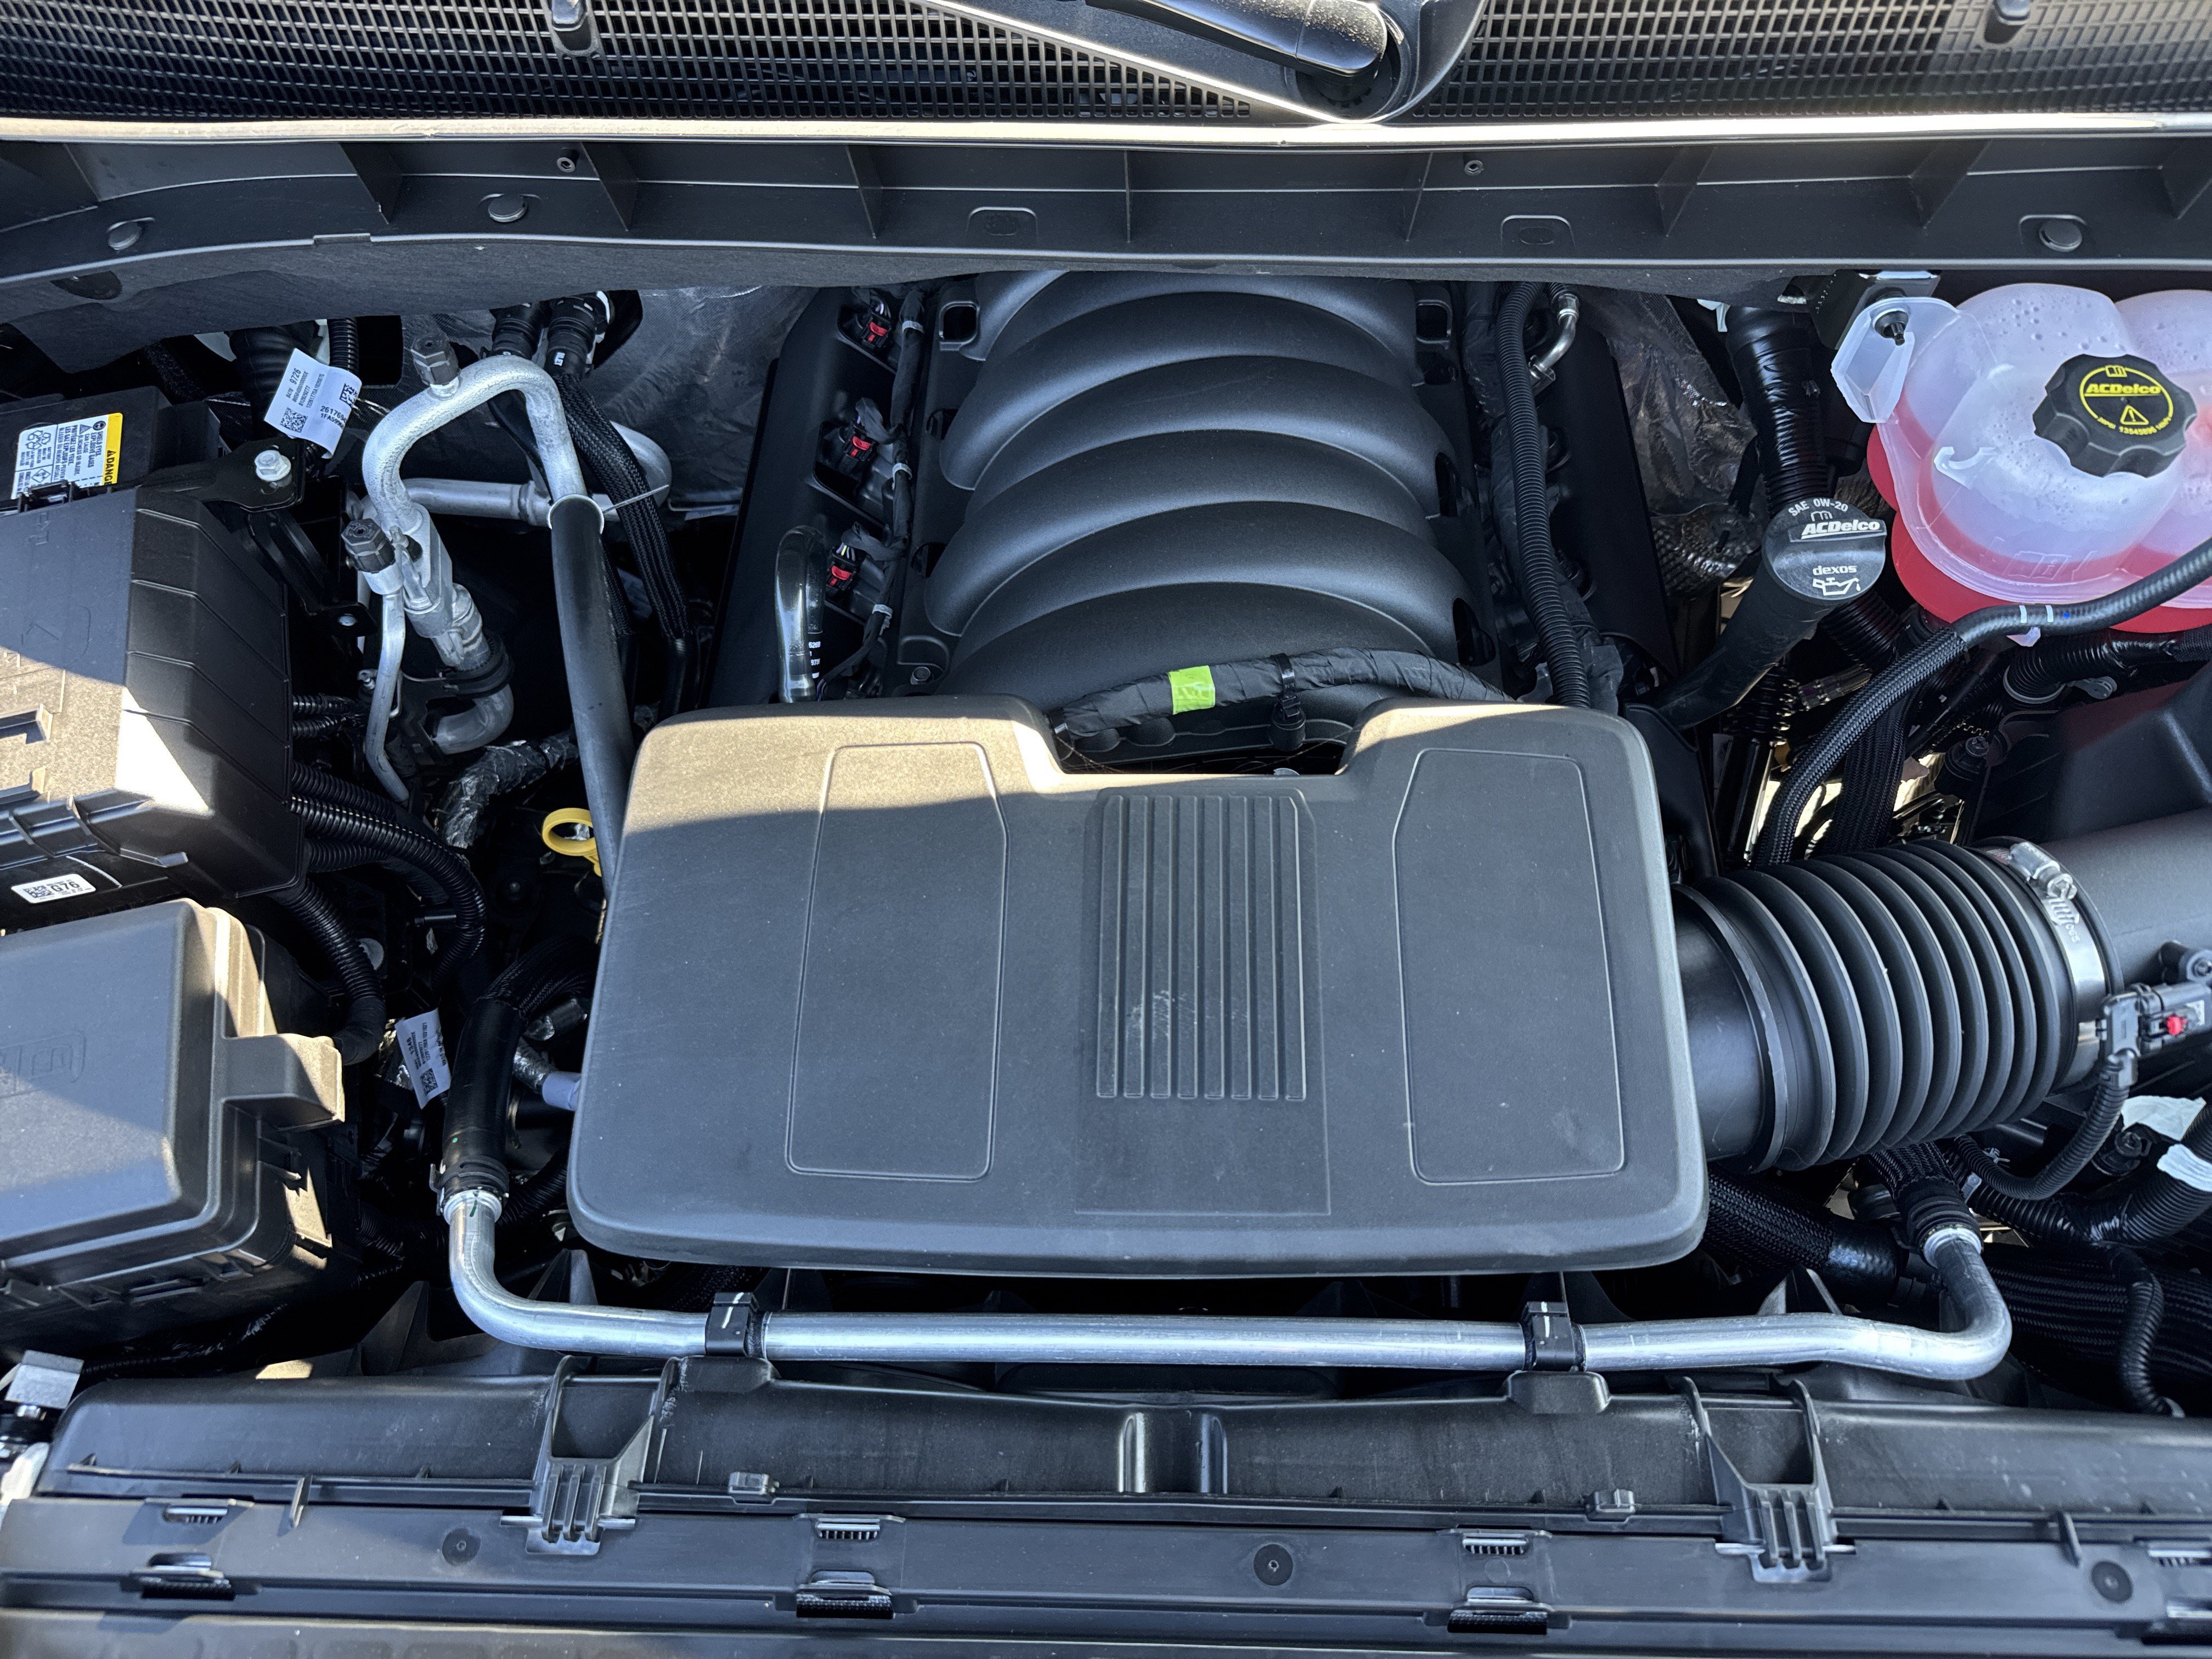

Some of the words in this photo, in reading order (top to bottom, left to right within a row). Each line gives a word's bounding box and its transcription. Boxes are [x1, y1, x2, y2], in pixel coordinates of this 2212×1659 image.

[289, 367, 302, 385] 9726
[2086, 382, 2162, 395] ACDelco
[1788, 500, 1809, 516] SAE
[1813, 498, 1848, 512] 0W-20
[1801, 521, 1880, 535] ACDelco
[1813, 565, 1857, 575] dexos
[50, 881, 80, 892] G76
[405, 1036, 415, 1055] 1348
